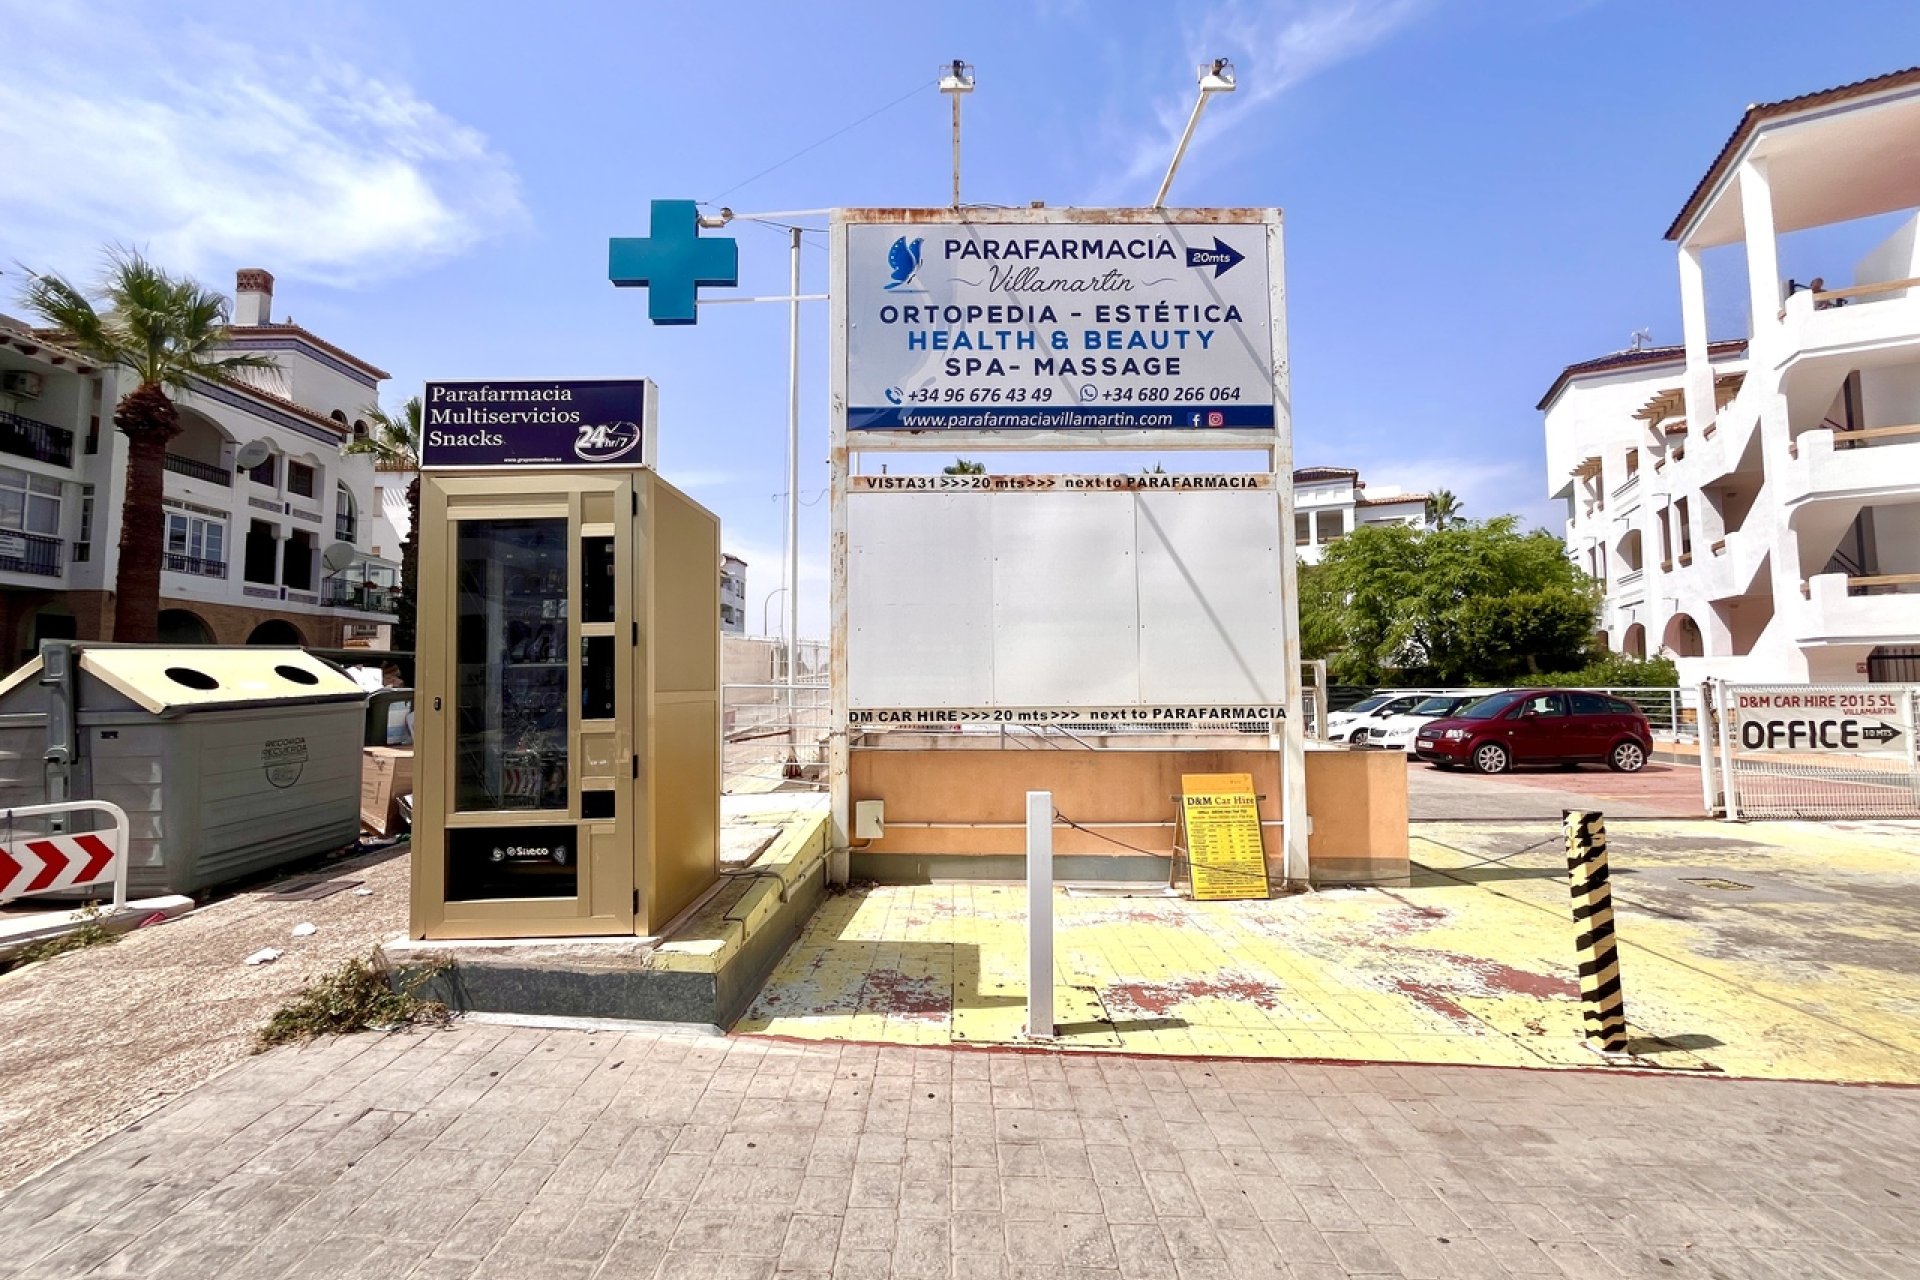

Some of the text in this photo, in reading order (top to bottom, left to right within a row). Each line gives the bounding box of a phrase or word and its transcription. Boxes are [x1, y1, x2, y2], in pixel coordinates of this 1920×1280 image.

[944, 239, 1177, 260] PARAFARMACIA
[1192, 252, 1231, 263] 20mts
[879, 304, 1058, 325] ORTOPEDIA
[1095, 300, 1243, 324] ESTÉTICA
[908, 330, 1215, 351] HEALTH & BEAUTY
[1034, 357, 1181, 377] MASSAGE
[430, 384, 573, 403] Parafarmacia
[908, 387, 1053, 402] +34 96 676 43 49
[1102, 387, 1241, 402] +34 680 266 064
[430, 407, 580, 425] Multiservicios
[902, 411, 1173, 429] www.parafarmaciavillamartin.com
[428, 429, 503, 447] Snacks
[866, 477, 936, 489] VISTA31
[1064, 477, 1100, 489] next
[1106, 477, 1121, 489] to
[1126, 477, 1258, 489] PARAFARMACIA
[1739, 694, 1896, 708] D&M CAR HIRE 2015 SL
[878, 711, 913, 722] CAR
[917, 711, 958, 722] HIRE
[1090, 708, 1127, 720] next
[1131, 708, 1148, 719] to
[1152, 708, 1287, 719] PARAFARMACIA
[1742, 720, 1859, 749] OFFICE
[1187, 796, 1213, 806] D&M
